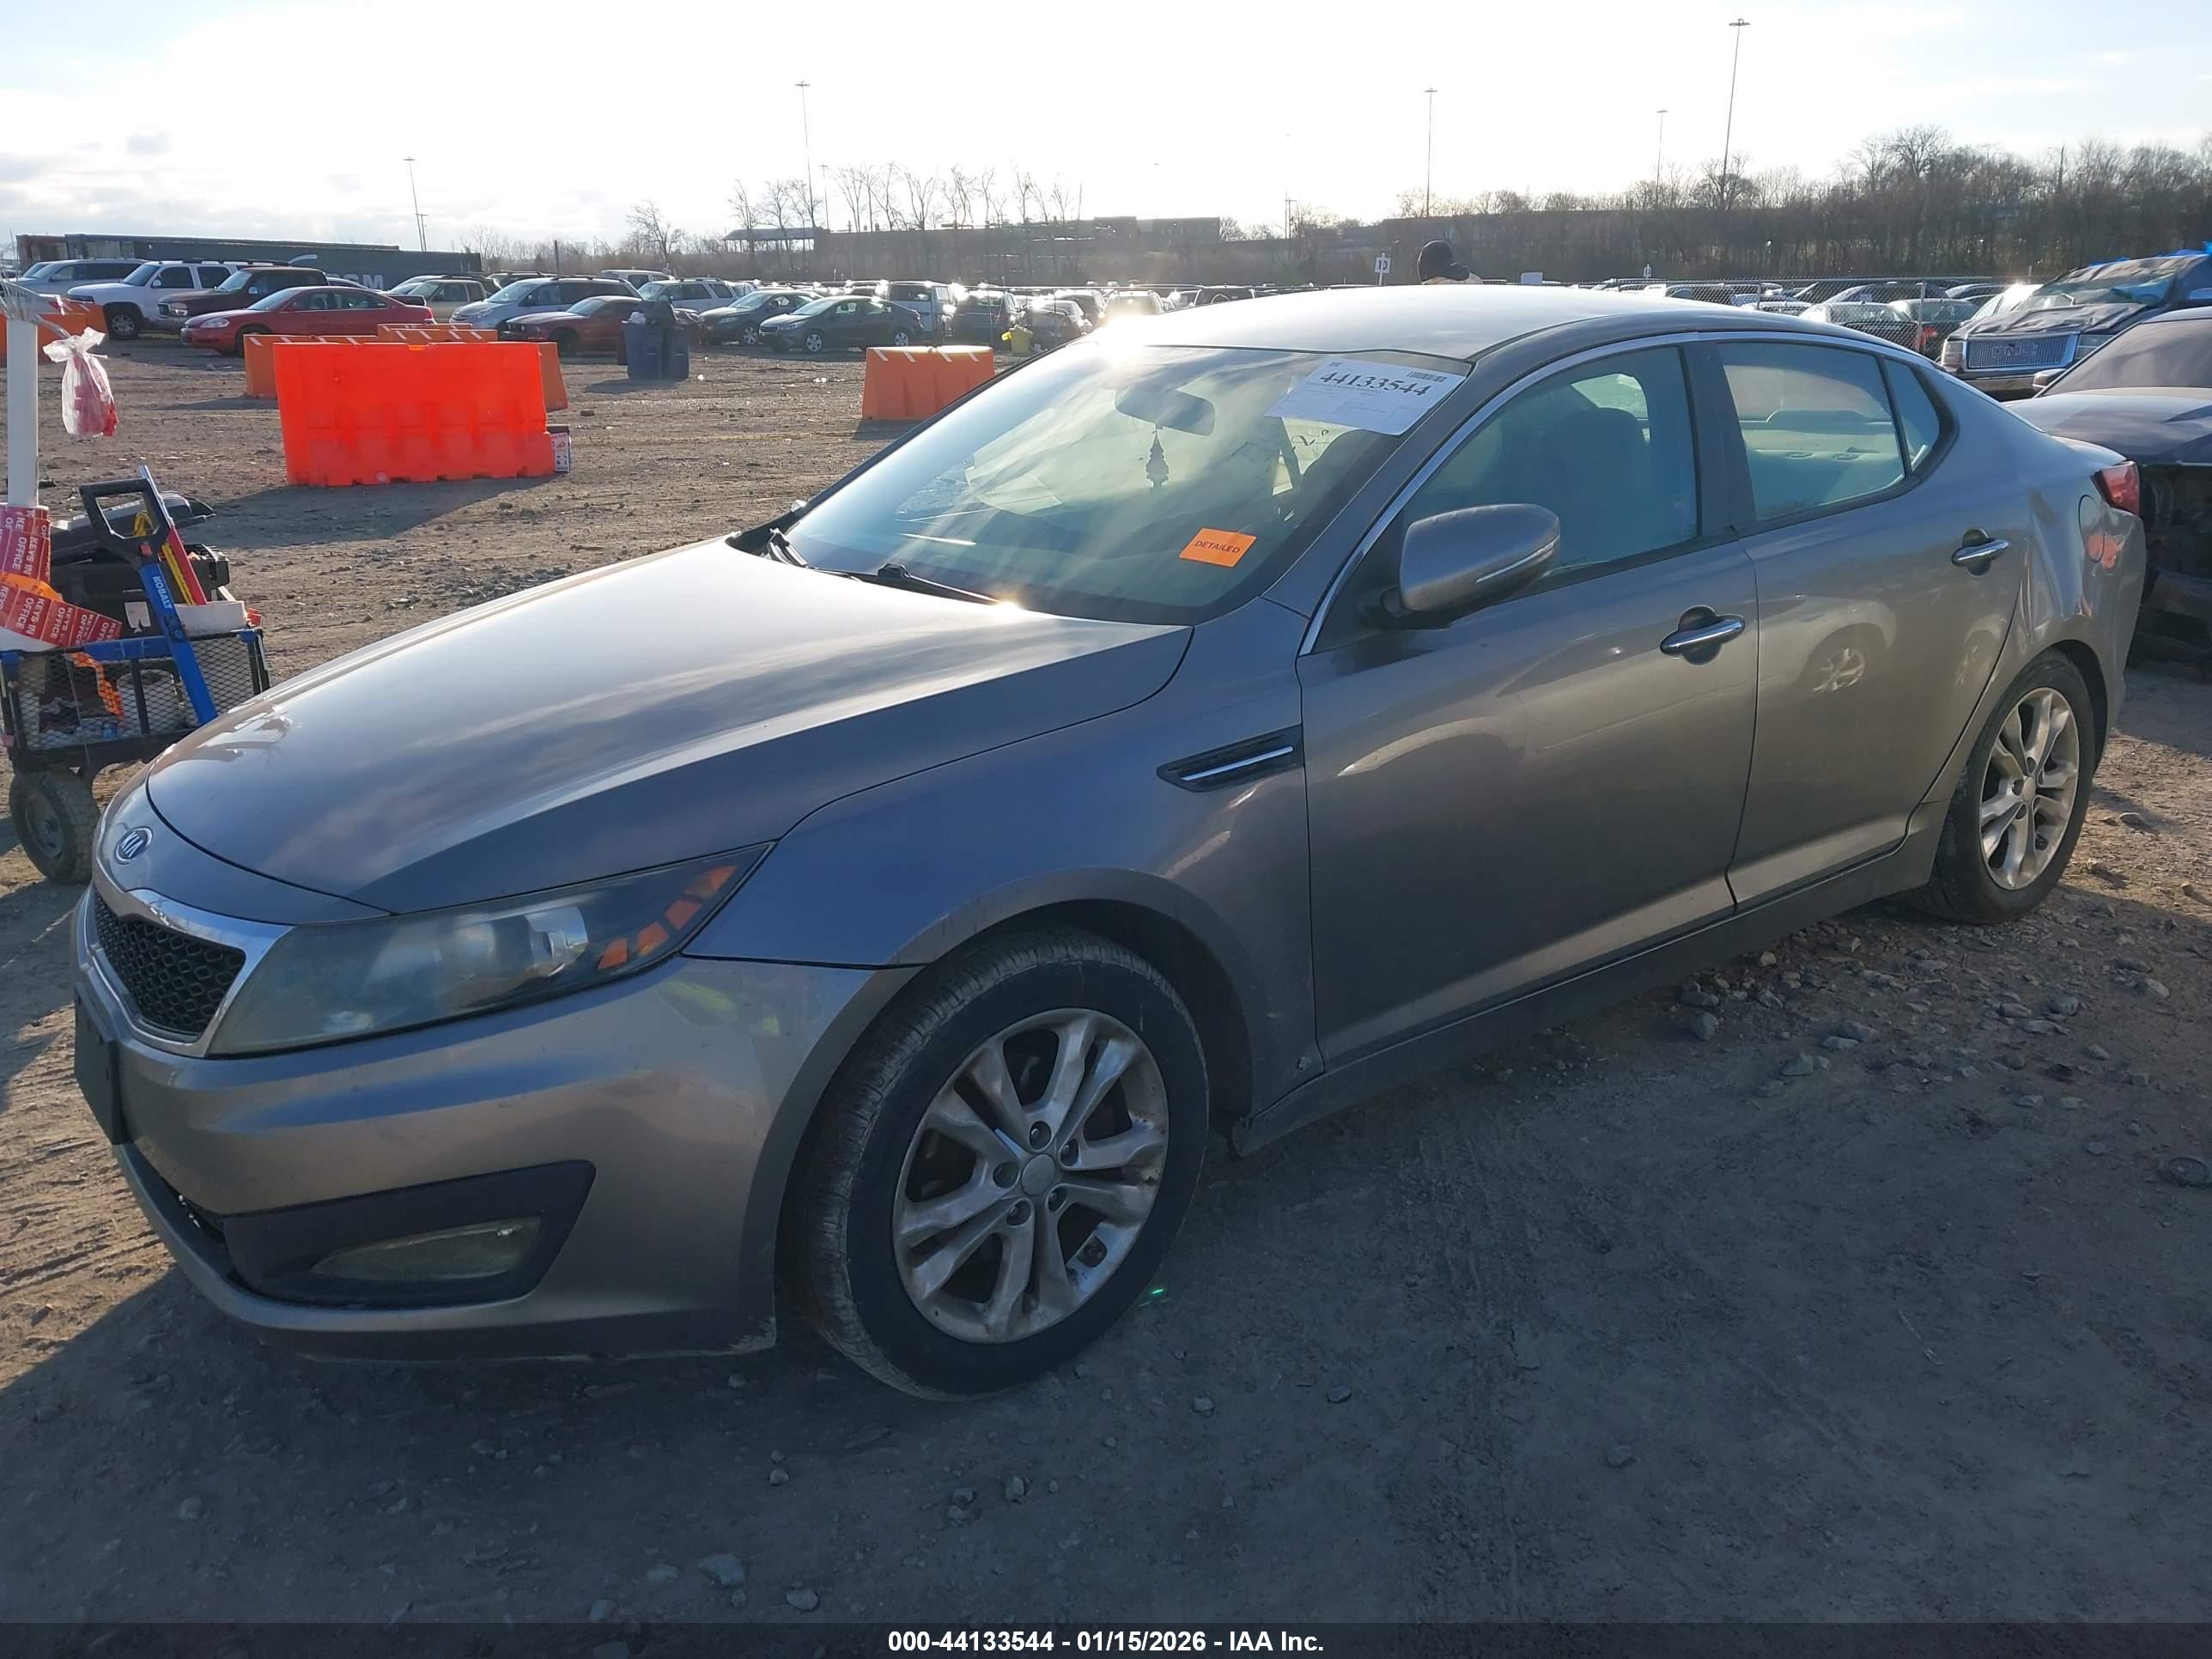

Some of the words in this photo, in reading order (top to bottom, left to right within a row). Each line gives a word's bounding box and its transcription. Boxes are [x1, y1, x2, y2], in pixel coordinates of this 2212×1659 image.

[1320, 371, 1431, 396] 44133544
[13, 537, 27, 570] OFFICE
[26, 536, 39, 562] KEYS
[1194, 540, 1241, 554] DETAILED
[22, 563, 33, 575] IN
[152, 575, 173, 609] KOBALT
[15, 598, 33, 629] OFFICE
[30, 598, 46, 623] KEYS
[51, 607, 66, 639] OFFICE
[26, 623, 36, 635] IN
[119, 830, 144, 859] KIA
